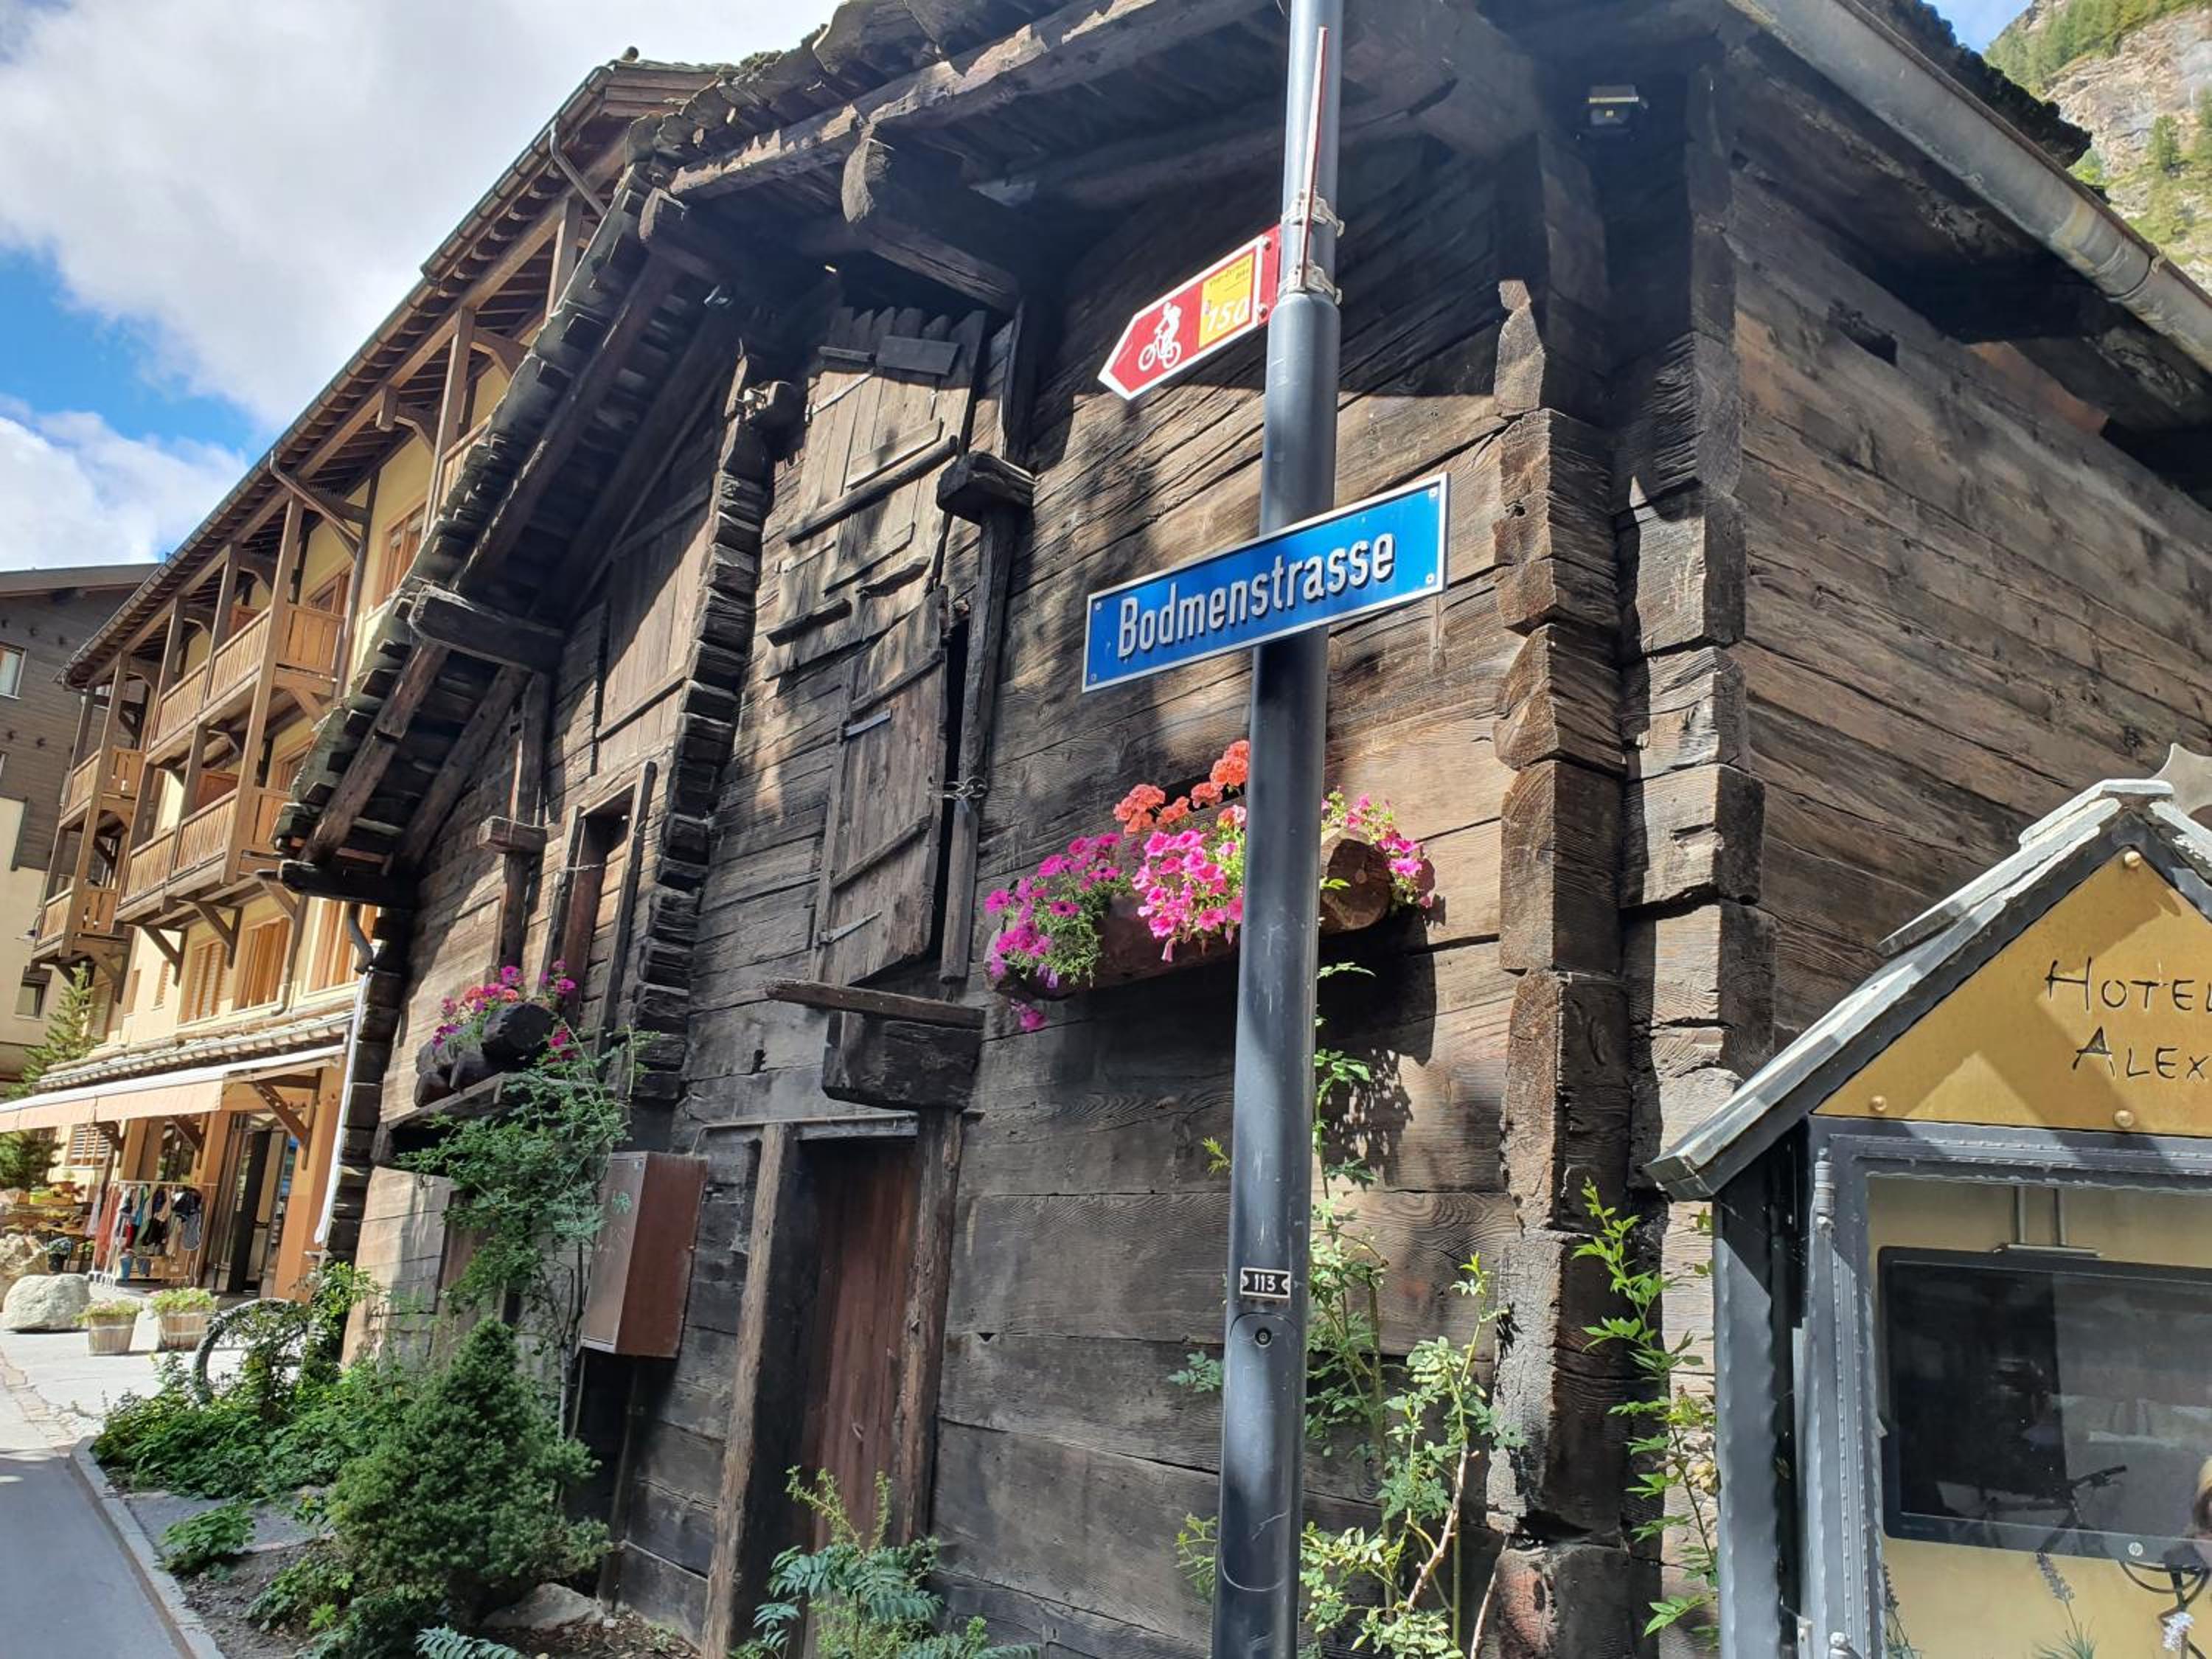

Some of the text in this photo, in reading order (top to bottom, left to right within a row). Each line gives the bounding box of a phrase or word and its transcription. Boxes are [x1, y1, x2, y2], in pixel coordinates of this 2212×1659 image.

[1118, 532, 1395, 658] Bodmenstrasse
[2072, 1026, 2209, 1079] ALEX
[1254, 1273, 1276, 1292] 113
